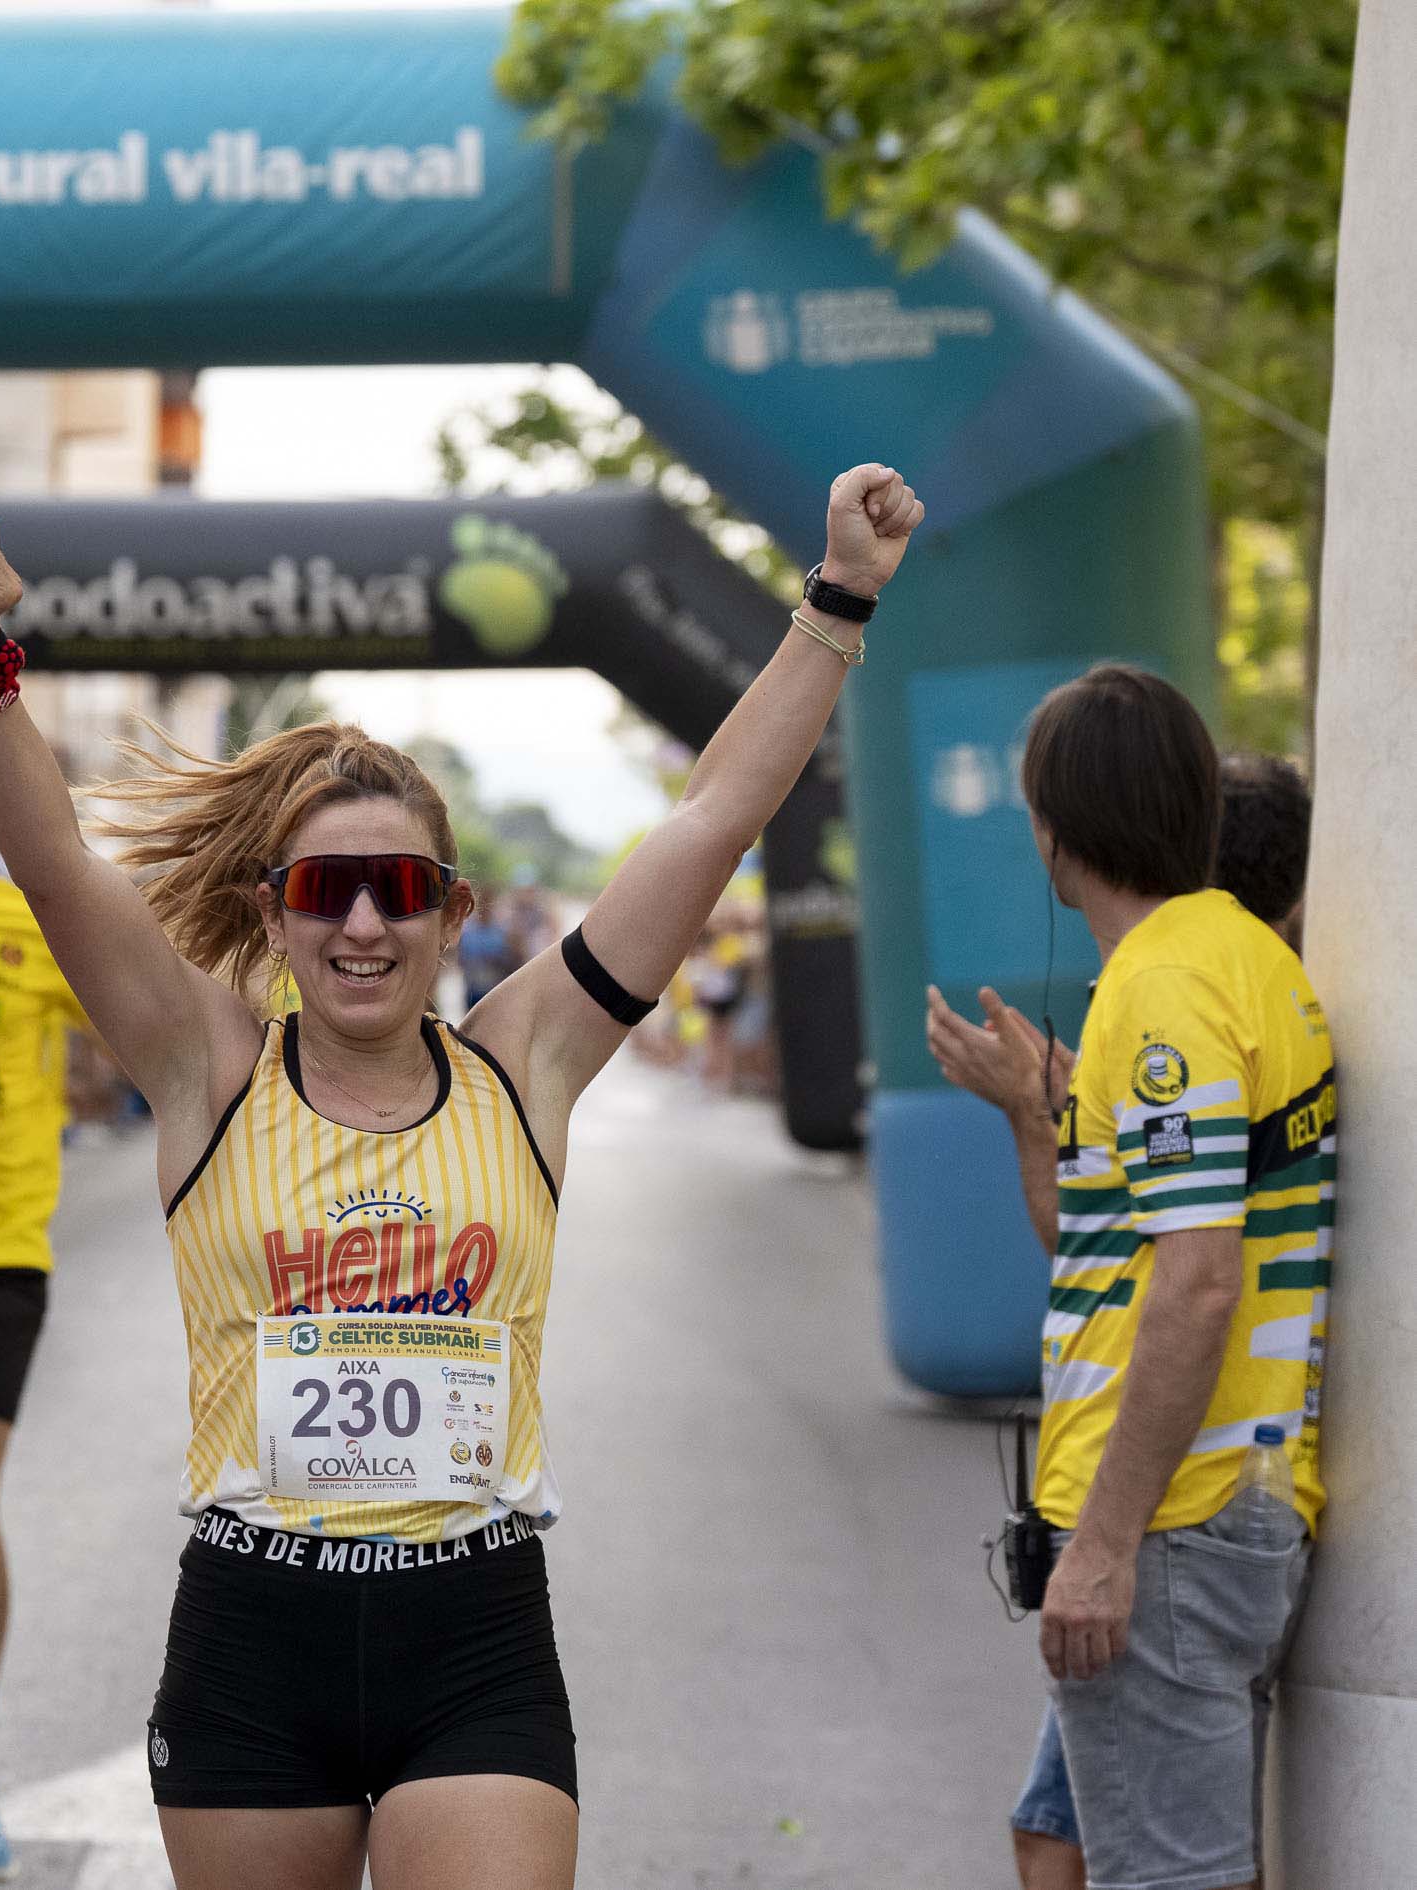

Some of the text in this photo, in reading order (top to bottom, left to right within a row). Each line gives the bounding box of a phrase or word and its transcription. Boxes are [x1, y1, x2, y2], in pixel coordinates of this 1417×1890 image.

[162, 125, 484, 202] vila-real
[337, 1320, 472, 1334] CURSA SOLIDÀRIA PER PARELLES
[328, 1330, 480, 1350] CELTIC SUBMARÍ
[337, 1361, 381, 1375] AIXA
[291, 1378, 421, 1438] 230
[270, 1465, 278, 1488] PENYA
[307, 1457, 416, 1479] COVALCA
[307, 1481, 417, 1490] COMERCIAL DE CARPINTERÍA
[265, 1531, 310, 1567] DE
[316, 1536, 471, 1574] MORELLA
